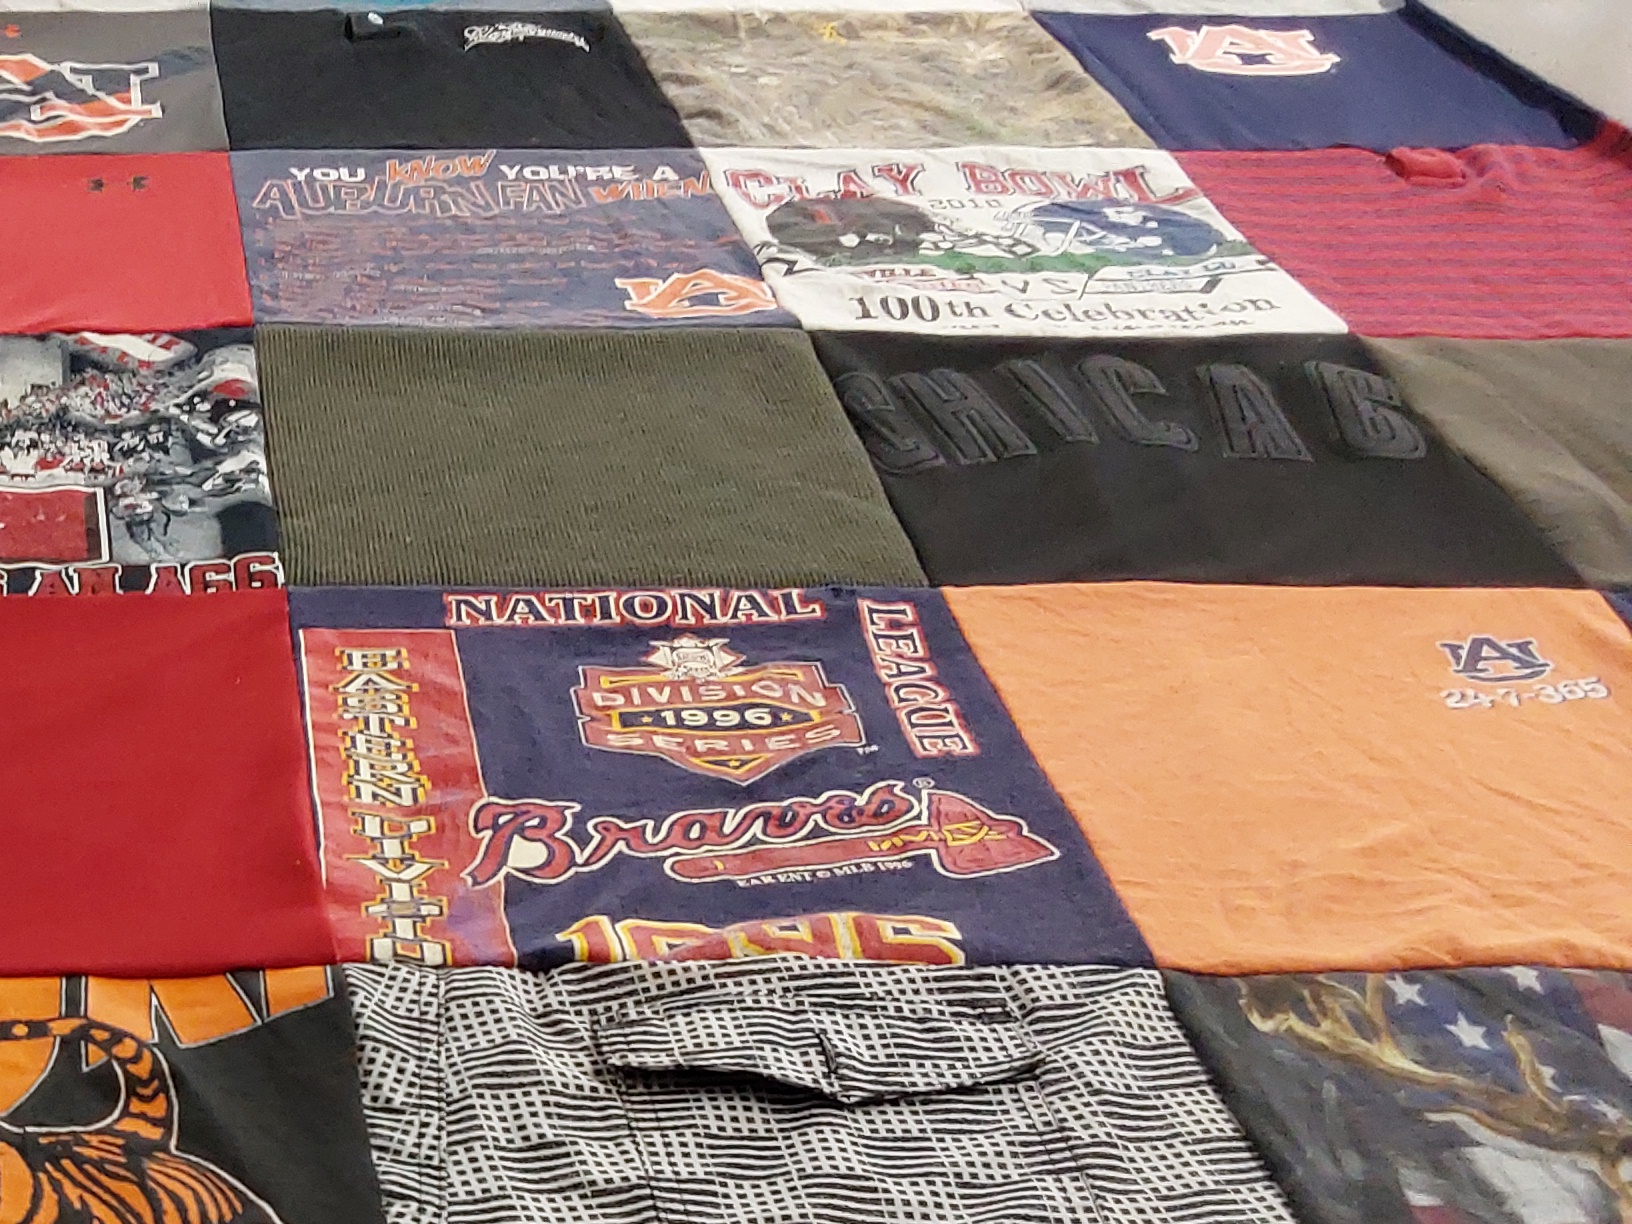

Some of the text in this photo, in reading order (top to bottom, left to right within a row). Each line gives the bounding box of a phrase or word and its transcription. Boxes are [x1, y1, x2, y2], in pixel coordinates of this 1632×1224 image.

[289, 149, 680, 183] YOU KNOW YOU'RE A
[956, 161, 1206, 202] BOWL
[251, 175, 502, 220] AUBURN
[498, 176, 588, 215] FAN
[849, 293, 1281, 324] 100th Celebration
[443, 589, 829, 626] NATIONAL
[592, 680, 827, 710] DIVISION
[858, 598, 979, 760] LEAGUE
[330, 647, 433, 807] EASTERN
[660, 707, 773, 727] 1996
[605, 724, 842, 754] SERIES
[463, 780, 923, 890] Braves
